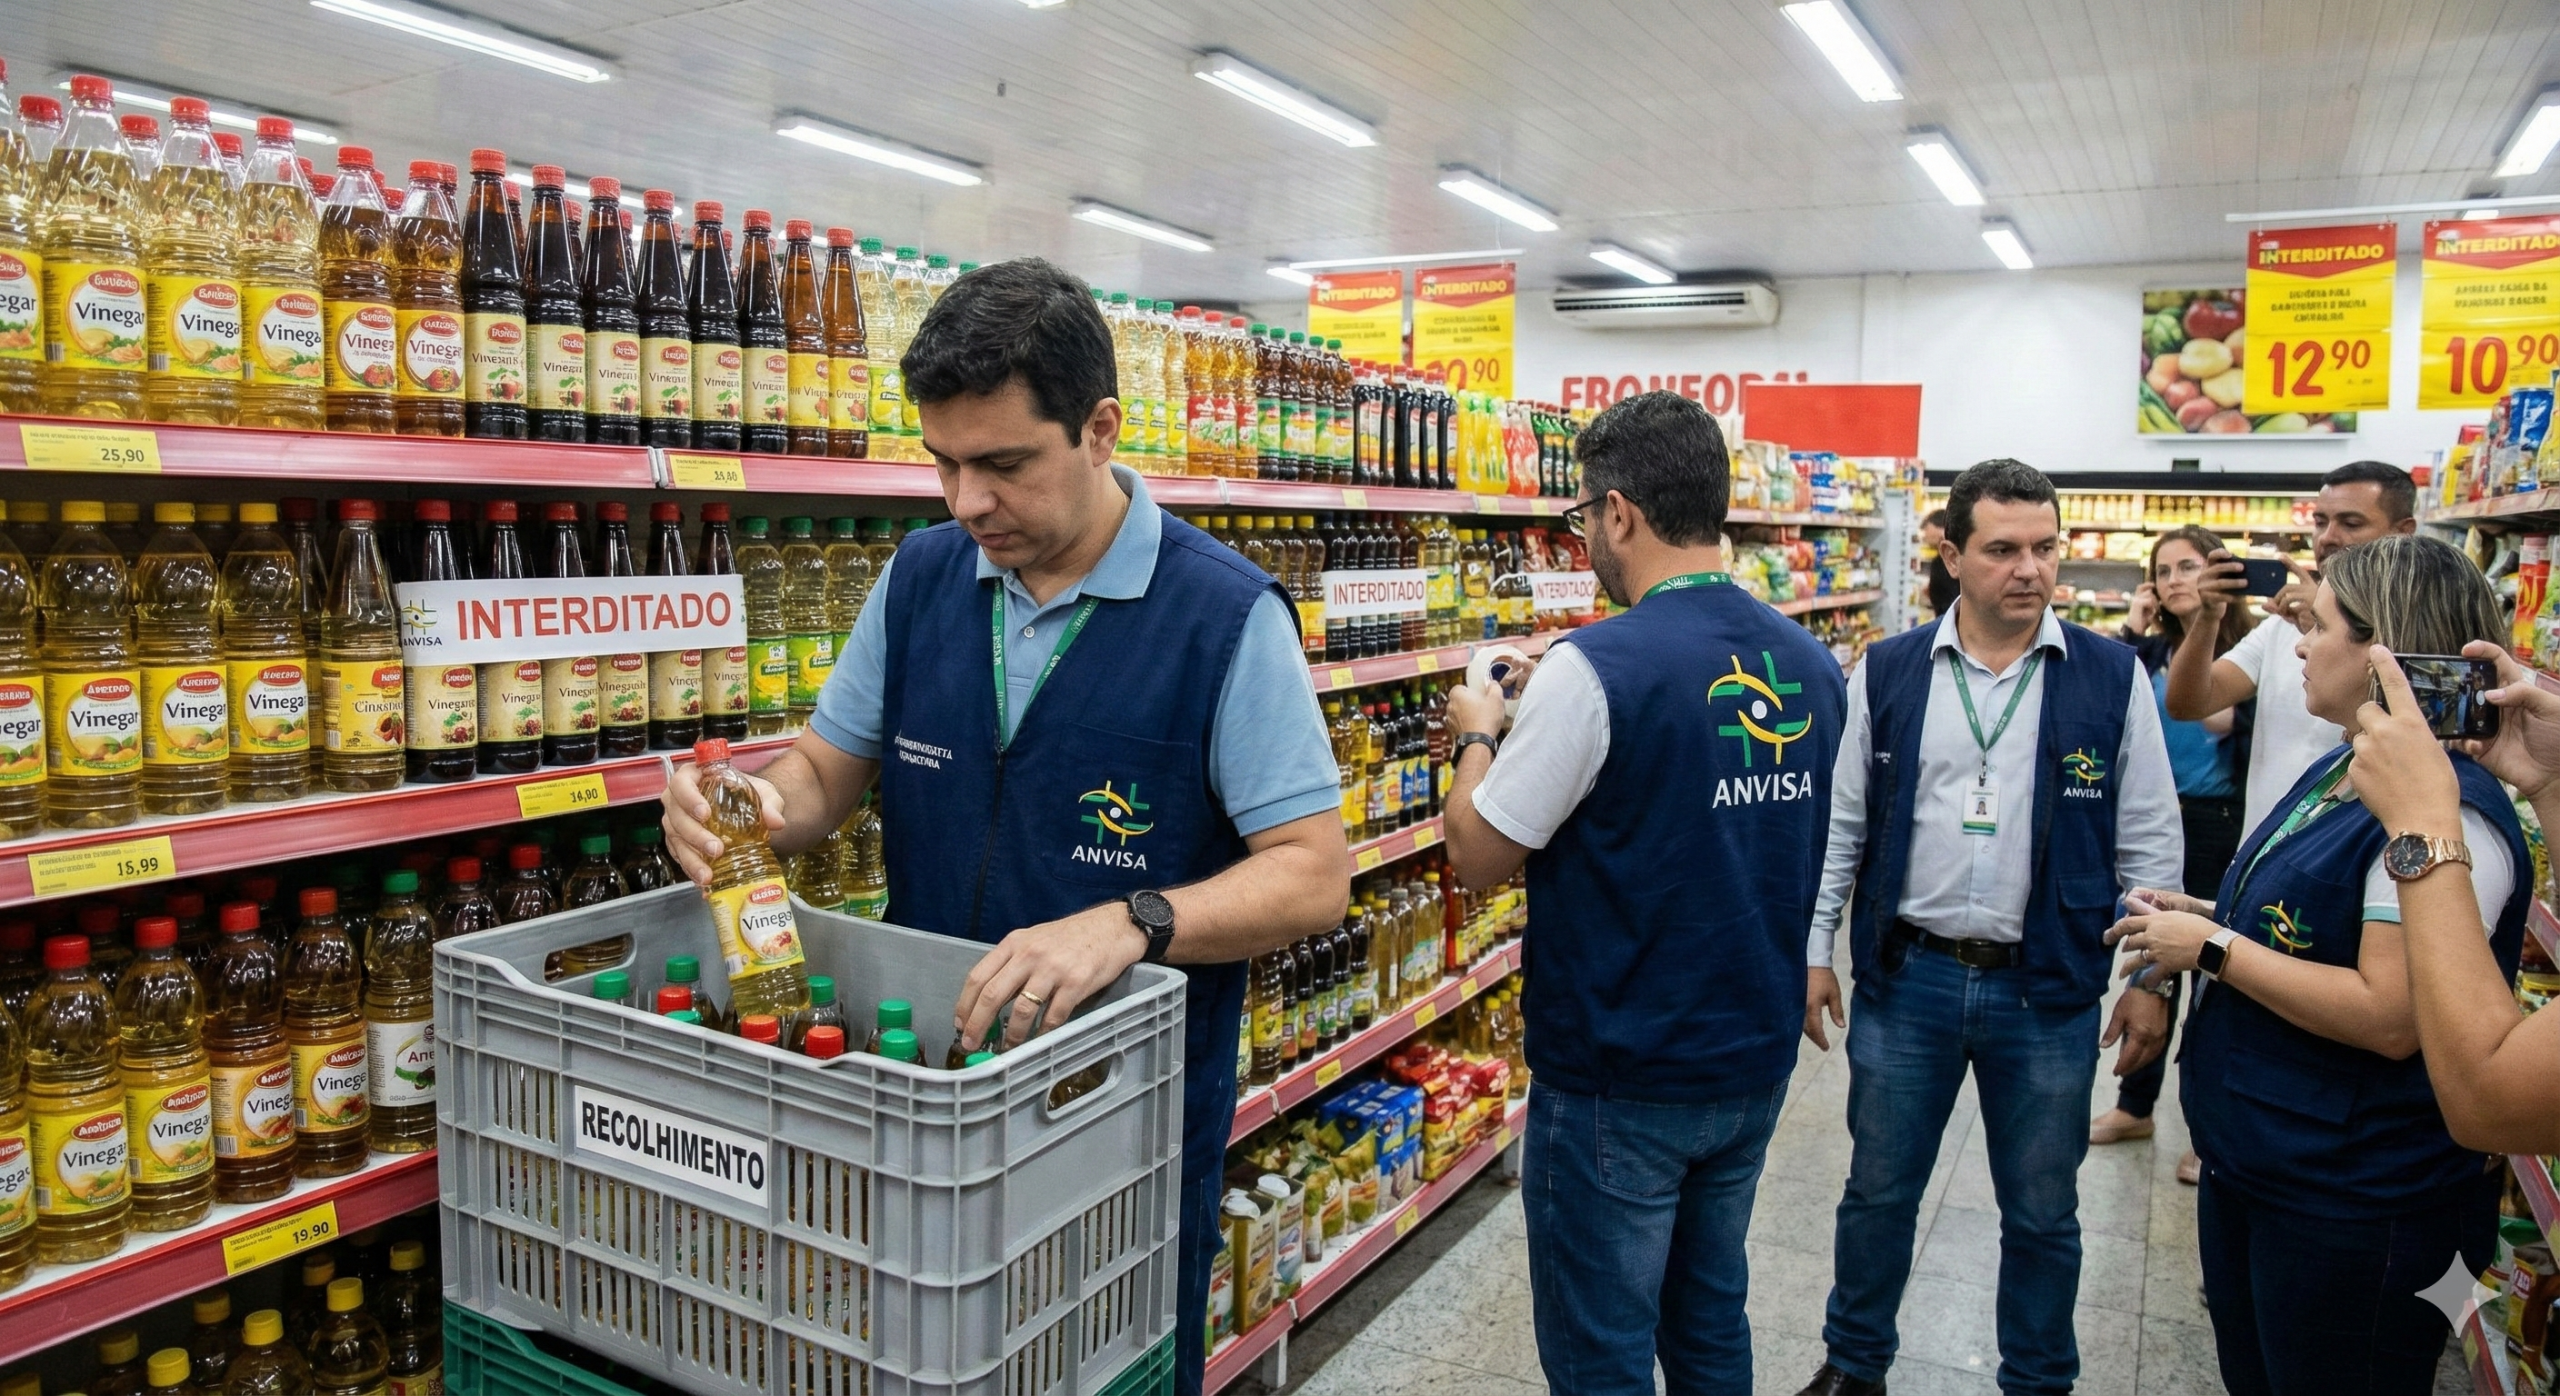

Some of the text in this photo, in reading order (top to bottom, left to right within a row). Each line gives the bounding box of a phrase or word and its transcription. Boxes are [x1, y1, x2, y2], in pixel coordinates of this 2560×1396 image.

[2259, 244, 2385, 265] INTERDITADO
[2435, 233, 2560, 257] INTERDITAD
[1421, 279, 1507, 297] INTERDITADO
[2268, 339, 2371, 398] 12 90
[2445, 333, 2559, 395] 10 90
[100, 448, 145, 465] 25,90
[1333, 580, 1424, 605] INTERDITADO
[457, 591, 732, 641] INTERDITADO
[1711, 770, 1813, 809] ANVISA
[2063, 786, 2103, 799] ANVISA
[1070, 844, 1147, 871] ANVISA
[582, 1100, 765, 1191] RECOLHIMENTO
[291, 1220, 330, 1245] 19,90
